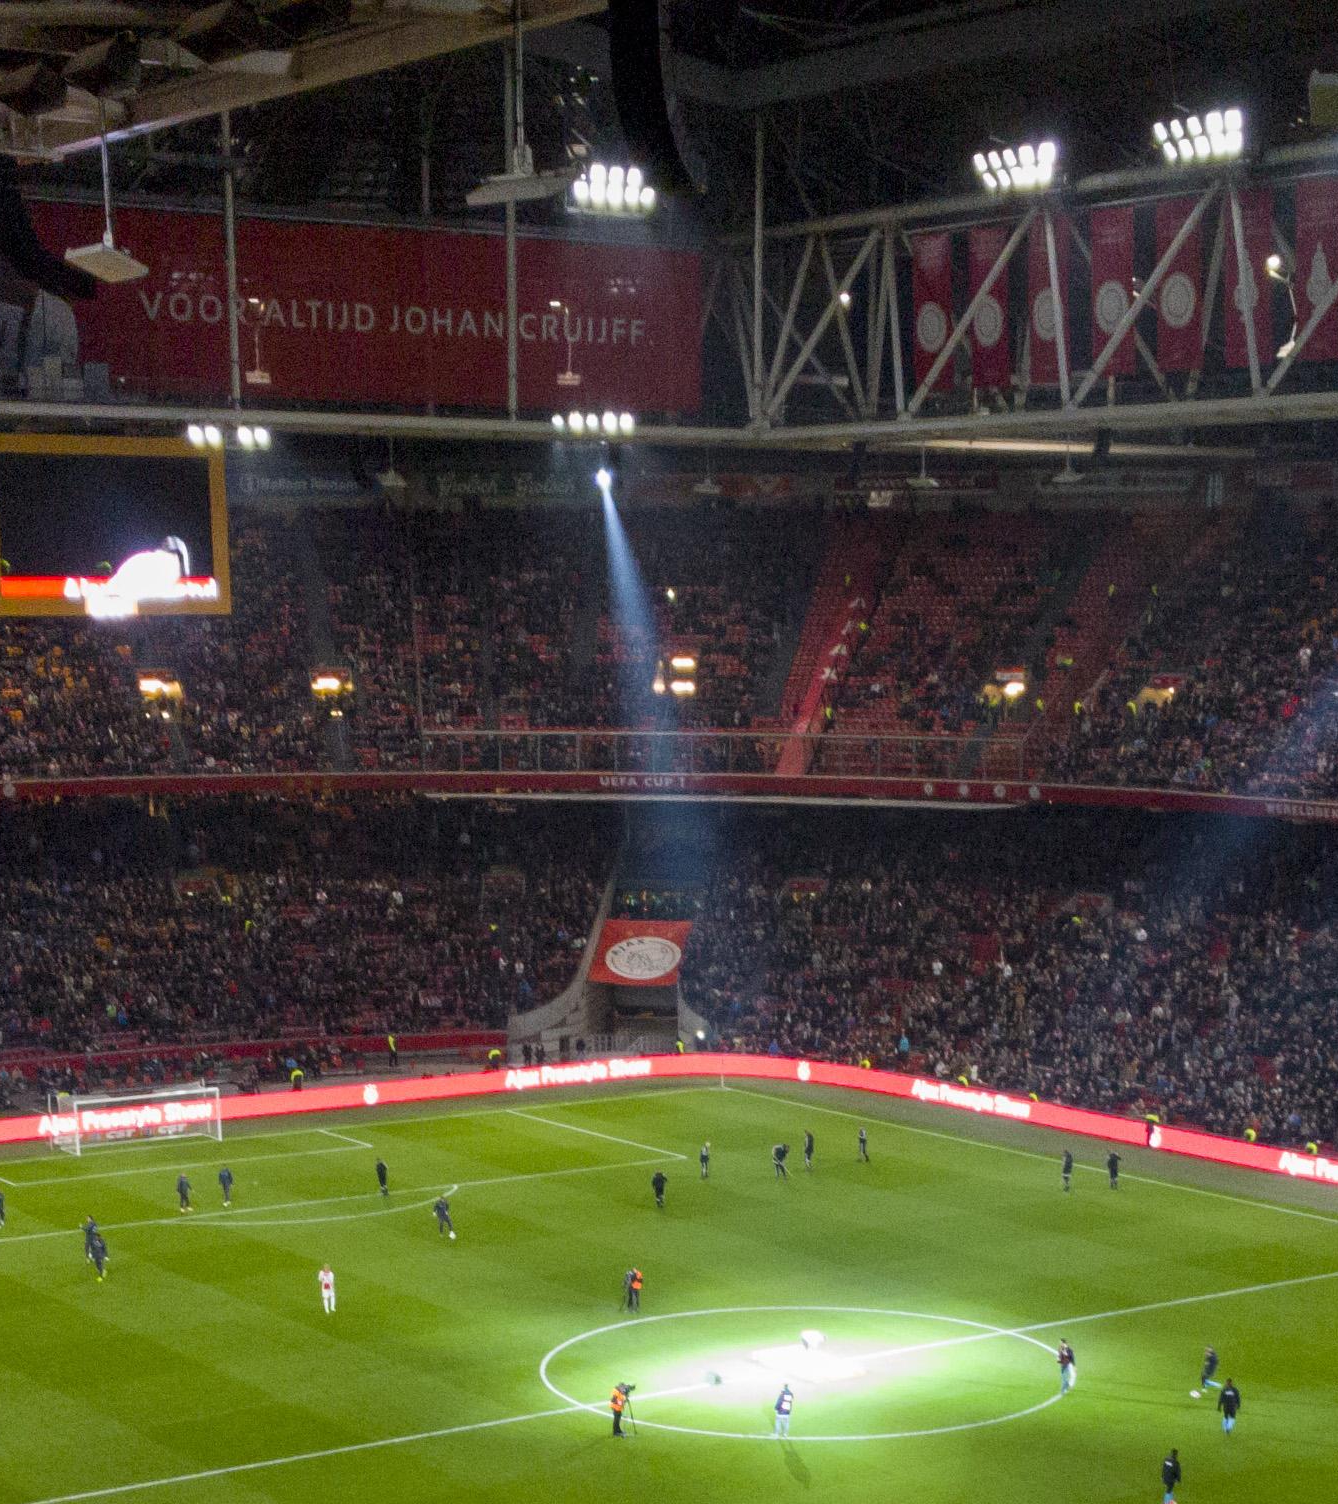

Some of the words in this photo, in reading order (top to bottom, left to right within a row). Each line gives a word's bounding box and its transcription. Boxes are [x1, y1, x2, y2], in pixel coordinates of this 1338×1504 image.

[139, 290, 249, 325] VOOR
[261, 298, 375, 332] ALTIJD
[390, 305, 505, 338] JOHAN
[599, 776, 638, 788] UEFA
[644, 777, 673, 788] CUP
[505, 1069, 540, 1090] Ajax
[609, 1059, 651, 1078] Show
[38, 1115, 78, 1136] Ajax
[163, 1103, 213, 1123] Show
[1278, 1152, 1315, 1176] Ajax
